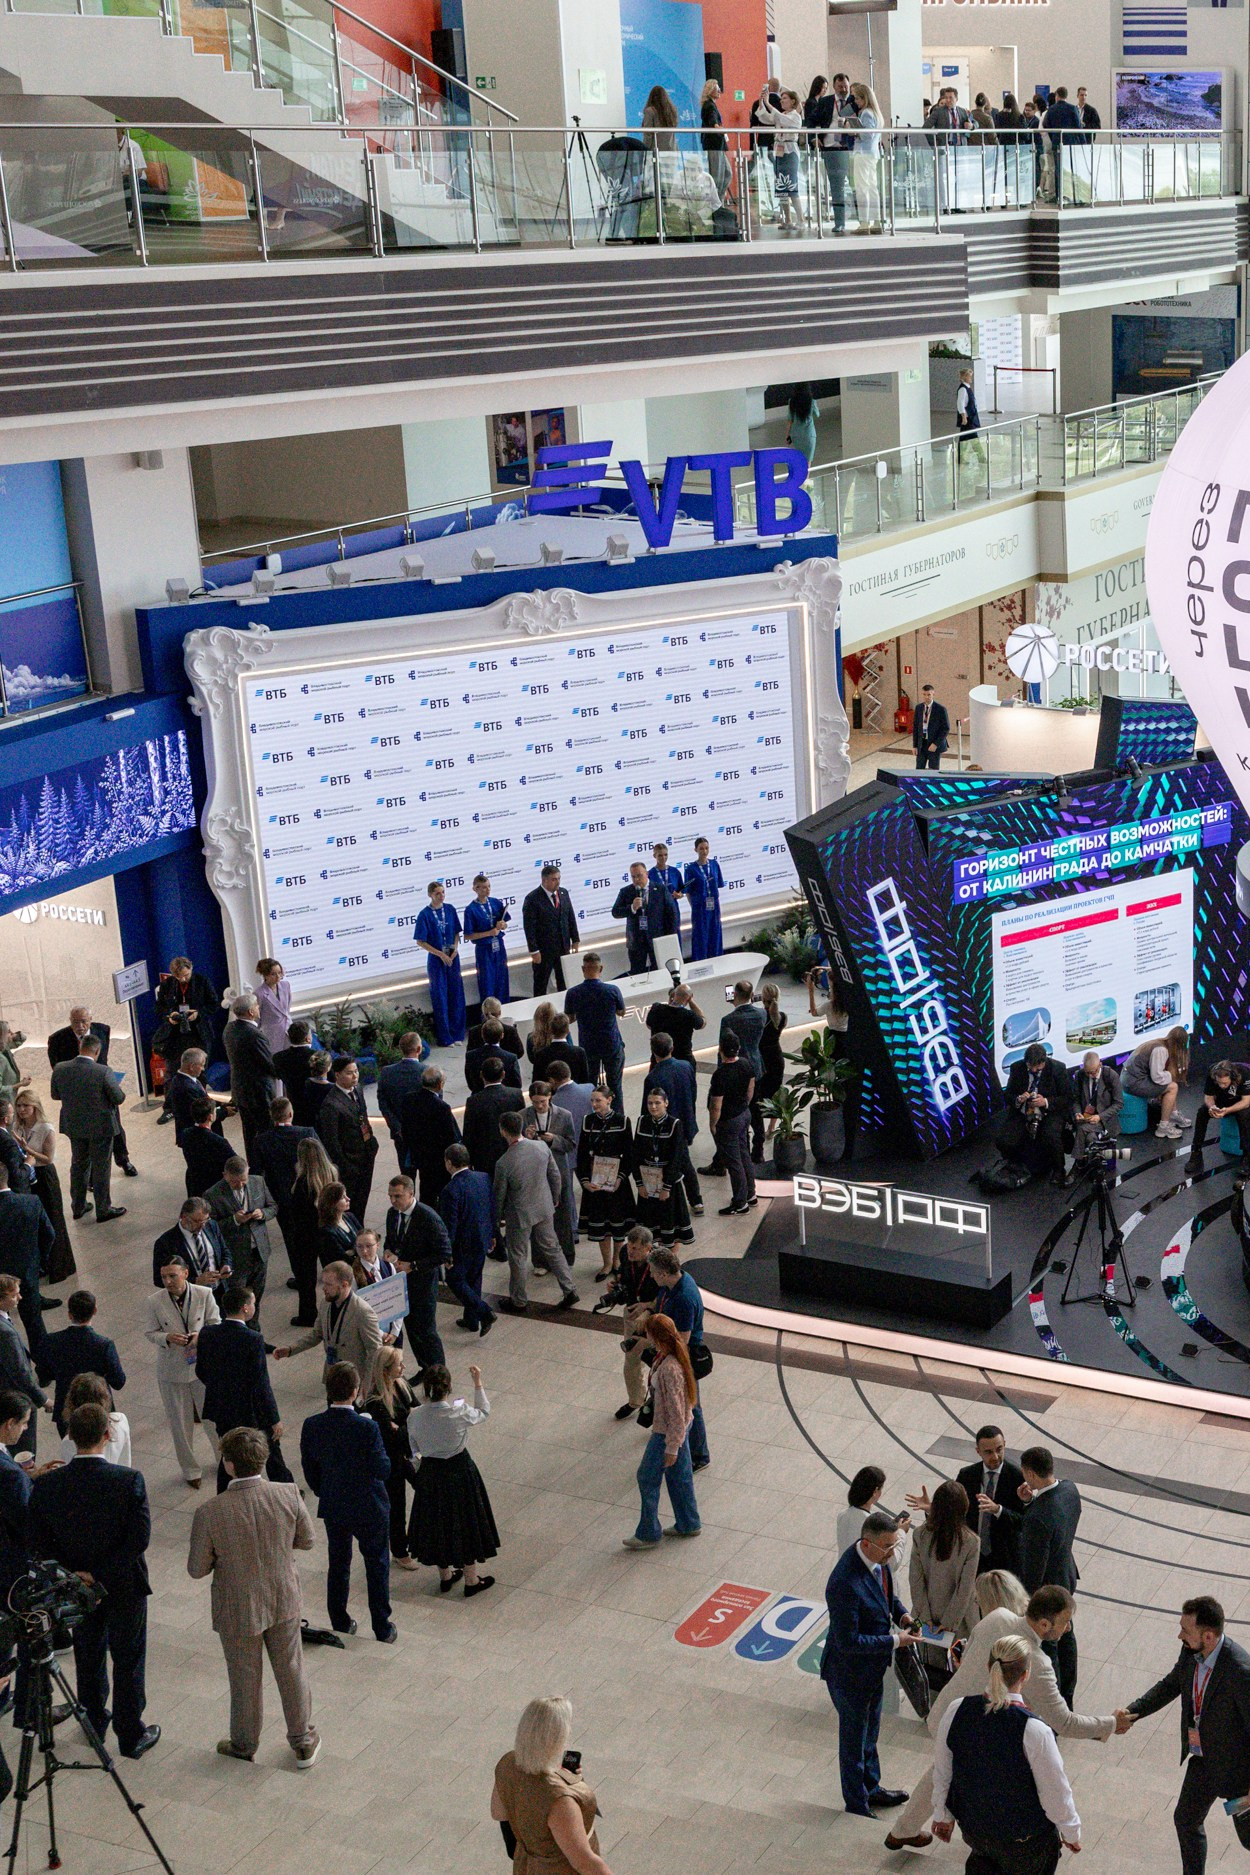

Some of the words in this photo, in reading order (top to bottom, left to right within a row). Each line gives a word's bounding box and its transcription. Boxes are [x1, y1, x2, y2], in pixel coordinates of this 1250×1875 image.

[619, 447, 813, 547] VTB
[1133, 494, 1155, 510] GOVER
[849, 568, 899, 597] ГОСТИНАЯ
[903, 547, 966, 577] ГУБЕРНАТОРОВ
[1186, 482, 1221, 658] через
[760, 625, 777, 634] ВТБ
[671, 636, 689, 646] ВТБ
[577, 649, 596, 658] ВТБ
[479, 661, 498, 671] ВТБ
[718, 659, 735, 669] ВТБ
[375, 675, 395, 685] ВТБ
[627, 672, 645, 681] ВТБ
[531, 685, 550, 695] ВТБ
[763, 681, 779, 690] ВТБ
[266, 689, 287, 700] ВТБ
[674, 694, 692, 703] ВТБ
[430, 698, 450, 709] ВТБ
[581, 707, 600, 717] ВТБ
[324, 713, 345, 724] ВТБ
[721, 715, 738, 725] ВТБ
[484, 721, 503, 732] ВТБ
[631, 729, 648, 739] ВТБ
[381, 736, 401, 747] ВТБ
[766, 736, 782, 746] ВТБ
[535, 744, 554, 754] ВТБ
[273, 752, 294, 763] ВТБ
[678, 750, 695, 760] ВТБ
[435, 759, 455, 769] ВТБ
[585, 765, 603, 775] ВТБ
[331, 775, 351, 786] ВТБ
[723, 771, 740, 781] ВТБ
[488, 780, 507, 791] ВТБ
[634, 786, 651, 796] ВТБ
[768, 791, 784, 800] ВТБ
[386, 797, 407, 808] ВТБ
[540, 801, 558, 812] ВТБ
[681, 806, 698, 816] ВТБ
[279, 814, 300, 825] ВТБ
[441, 818, 460, 829] ВТБ
[589, 822, 607, 832] ВТБ
[726, 825, 743, 835] ВТБ
[337, 836, 357, 847] ВТБ
[493, 839, 512, 849] ВТБ
[960, 848, 1037, 878] ГОРИЗОНТ
[1041, 834, 1107, 860] ЧЕСТНЫХ
[1110, 806, 1228, 845] ВОЗМОЖНОСТЕЙ:
[770, 844, 786, 854] ВТБ
[392, 857, 412, 867] ВТБ
[959, 882, 979, 899] ОТ
[983, 858, 1098, 893] КАЛИНИНГРАДА
[1100, 851, 1121, 869] ДО
[1124, 833, 1198, 861] КАМЧАТКИ
[286, 875, 307, 887] ВТБ
[445, 876, 465, 888] ВТБ
[593, 878, 611, 889] ВТБ
[729, 879, 746, 890] ВТБ
[343, 896, 363, 907] ВТБ
[40, 902, 106, 926] РОССЕТИ
[1001, 916, 1024, 927] ПЛАНЫ
[1034, 904, 1073, 919] РЕАЛИЗАЦИИ
[1073, 898, 1103, 910] ПРОЕКТОВ
[1103, 894, 1115, 903] ГЧП
[292, 936, 313, 947] ВТБ
[349, 955, 369, 966] ВТБ
[708, 1608, 733, 1624] S
[761, 1600, 829, 1642] D
